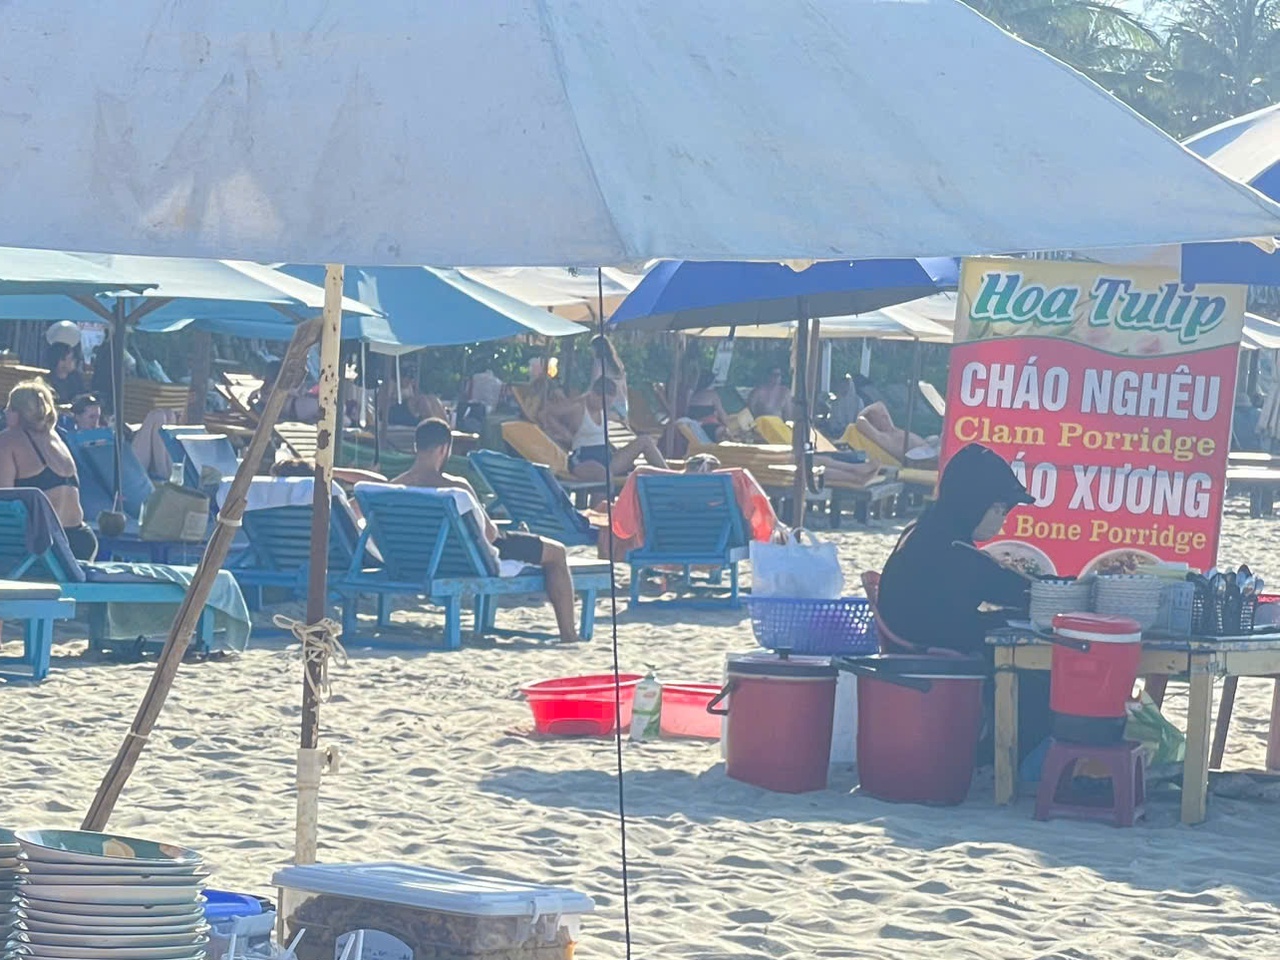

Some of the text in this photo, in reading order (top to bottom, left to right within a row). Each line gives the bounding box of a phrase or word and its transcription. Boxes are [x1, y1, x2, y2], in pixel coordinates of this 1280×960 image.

[972, 272, 1227, 343] Hoa Tulip
[960, 356, 1220, 421] CHÁO NGHÊU
[954, 416, 1216, 461] Clam Porridge
[1068, 463, 1212, 519] XƯƠNG
[1014, 515, 1081, 541] Bone
[1089, 520, 1206, 554] Porridge
